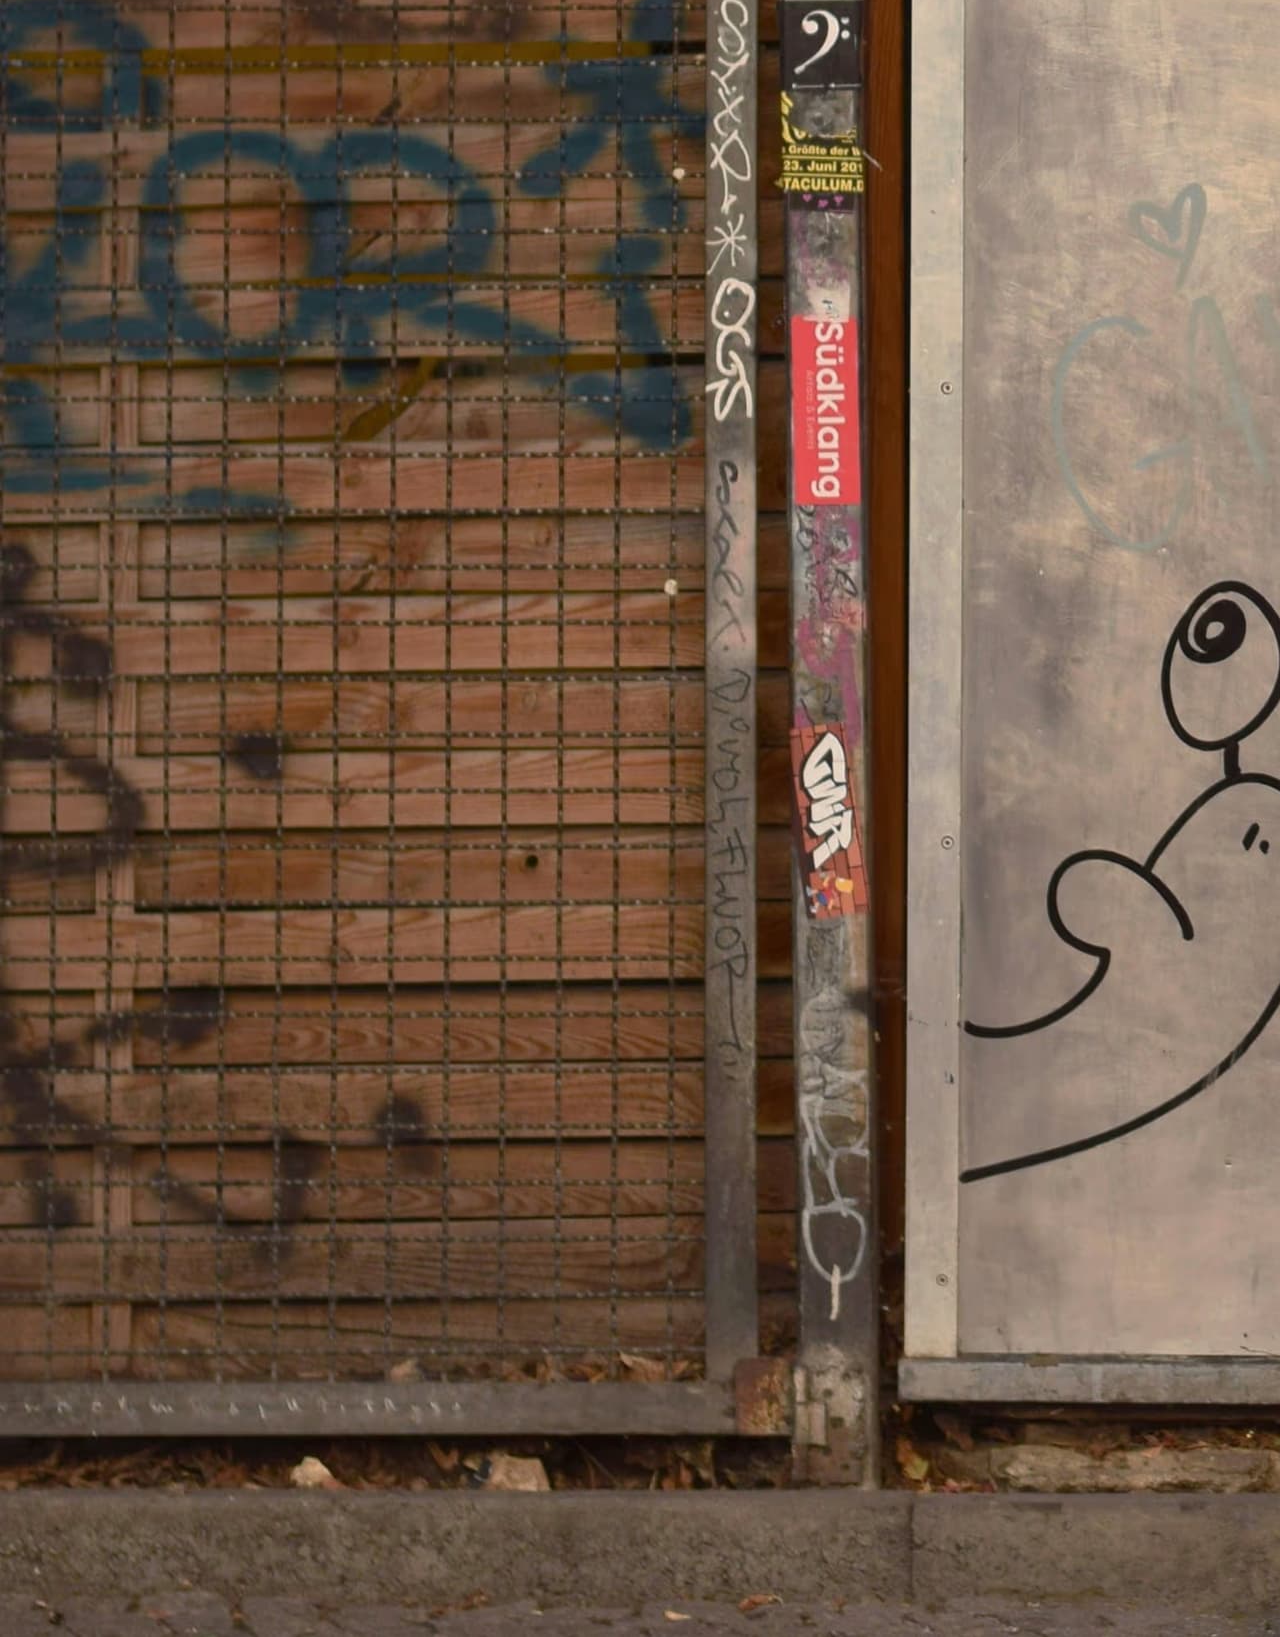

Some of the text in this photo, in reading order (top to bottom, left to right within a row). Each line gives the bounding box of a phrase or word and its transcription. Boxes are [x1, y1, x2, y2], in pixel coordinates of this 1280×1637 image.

[783, 160, 803, 172] 23.
[807, 160, 837, 172] Juni
[811, 321, 846, 498] Südklang
